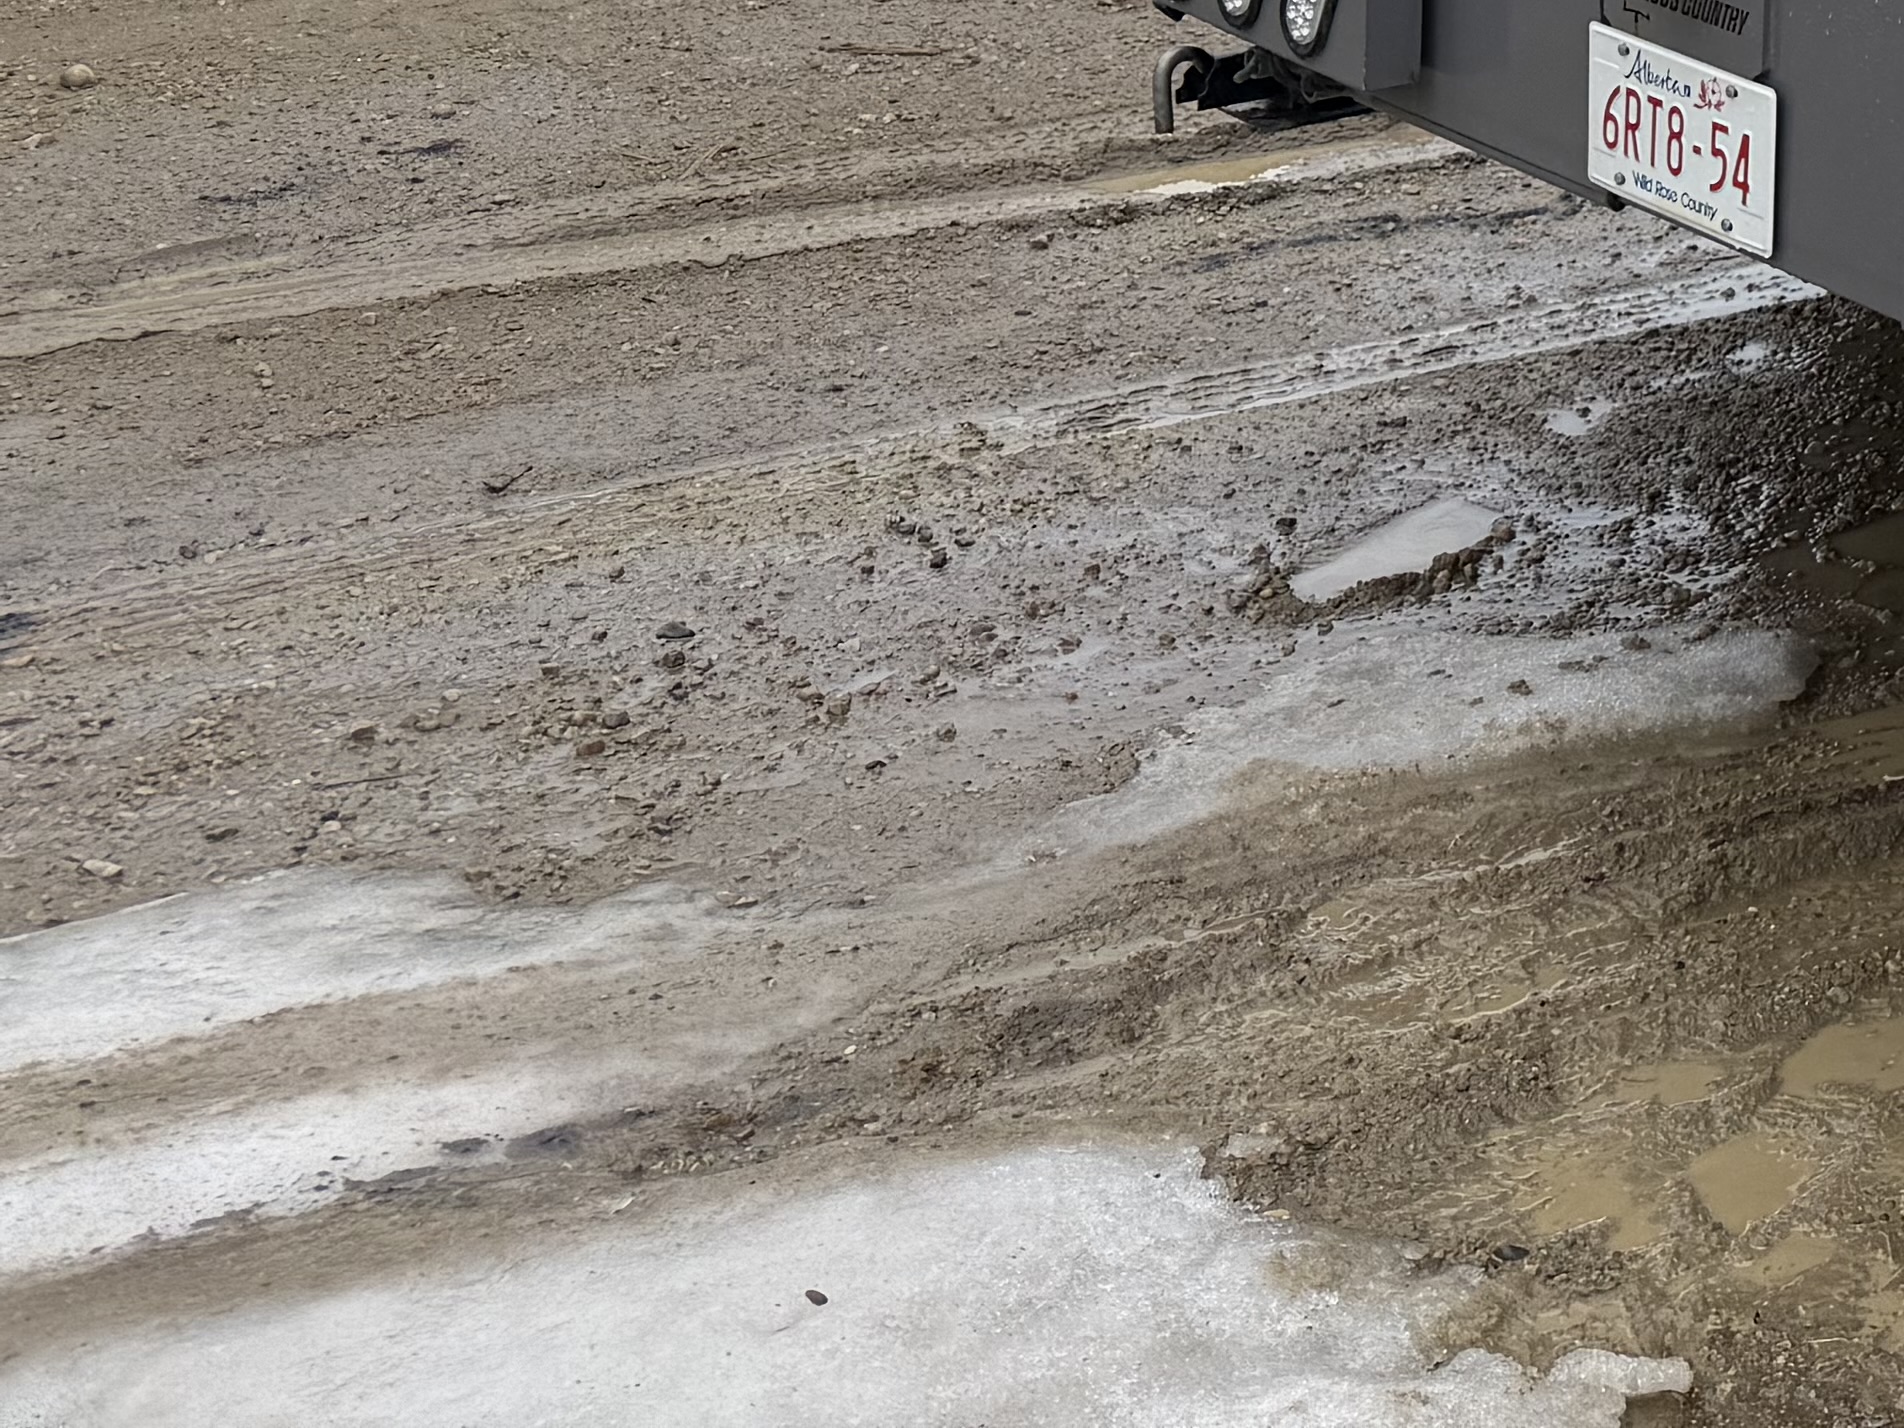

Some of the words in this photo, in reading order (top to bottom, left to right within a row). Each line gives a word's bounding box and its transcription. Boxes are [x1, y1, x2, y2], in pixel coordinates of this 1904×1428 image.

[1602, 84, 1751, 207] 6RT8-54
[1631, 169, 1653, 193] Wild
[1655, 180, 1678, 203] Rose
